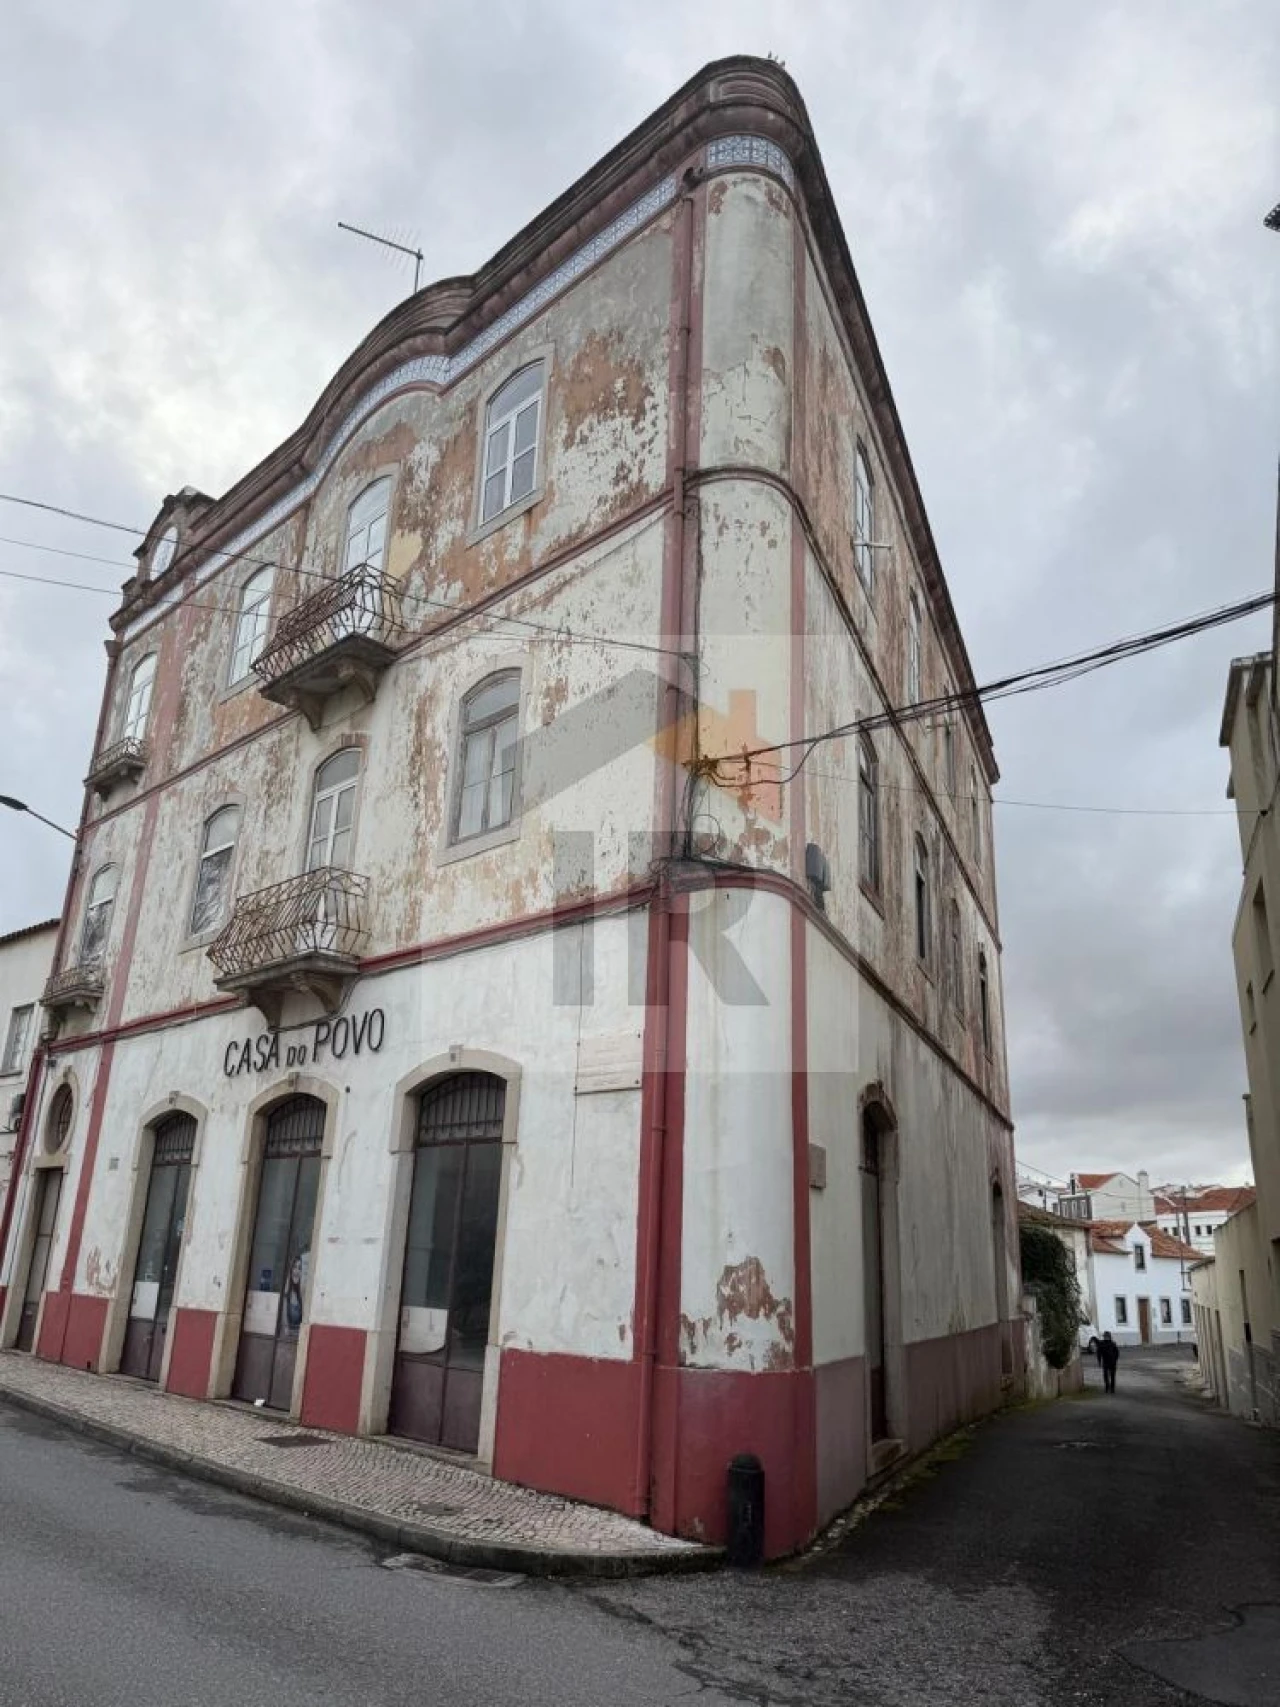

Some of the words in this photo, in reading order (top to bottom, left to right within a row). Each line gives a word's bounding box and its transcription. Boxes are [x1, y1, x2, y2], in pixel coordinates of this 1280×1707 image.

[223, 1031, 280, 1077] CASA
[286, 1045, 308, 1066] DO
[312, 1008, 385, 1063] POVO
